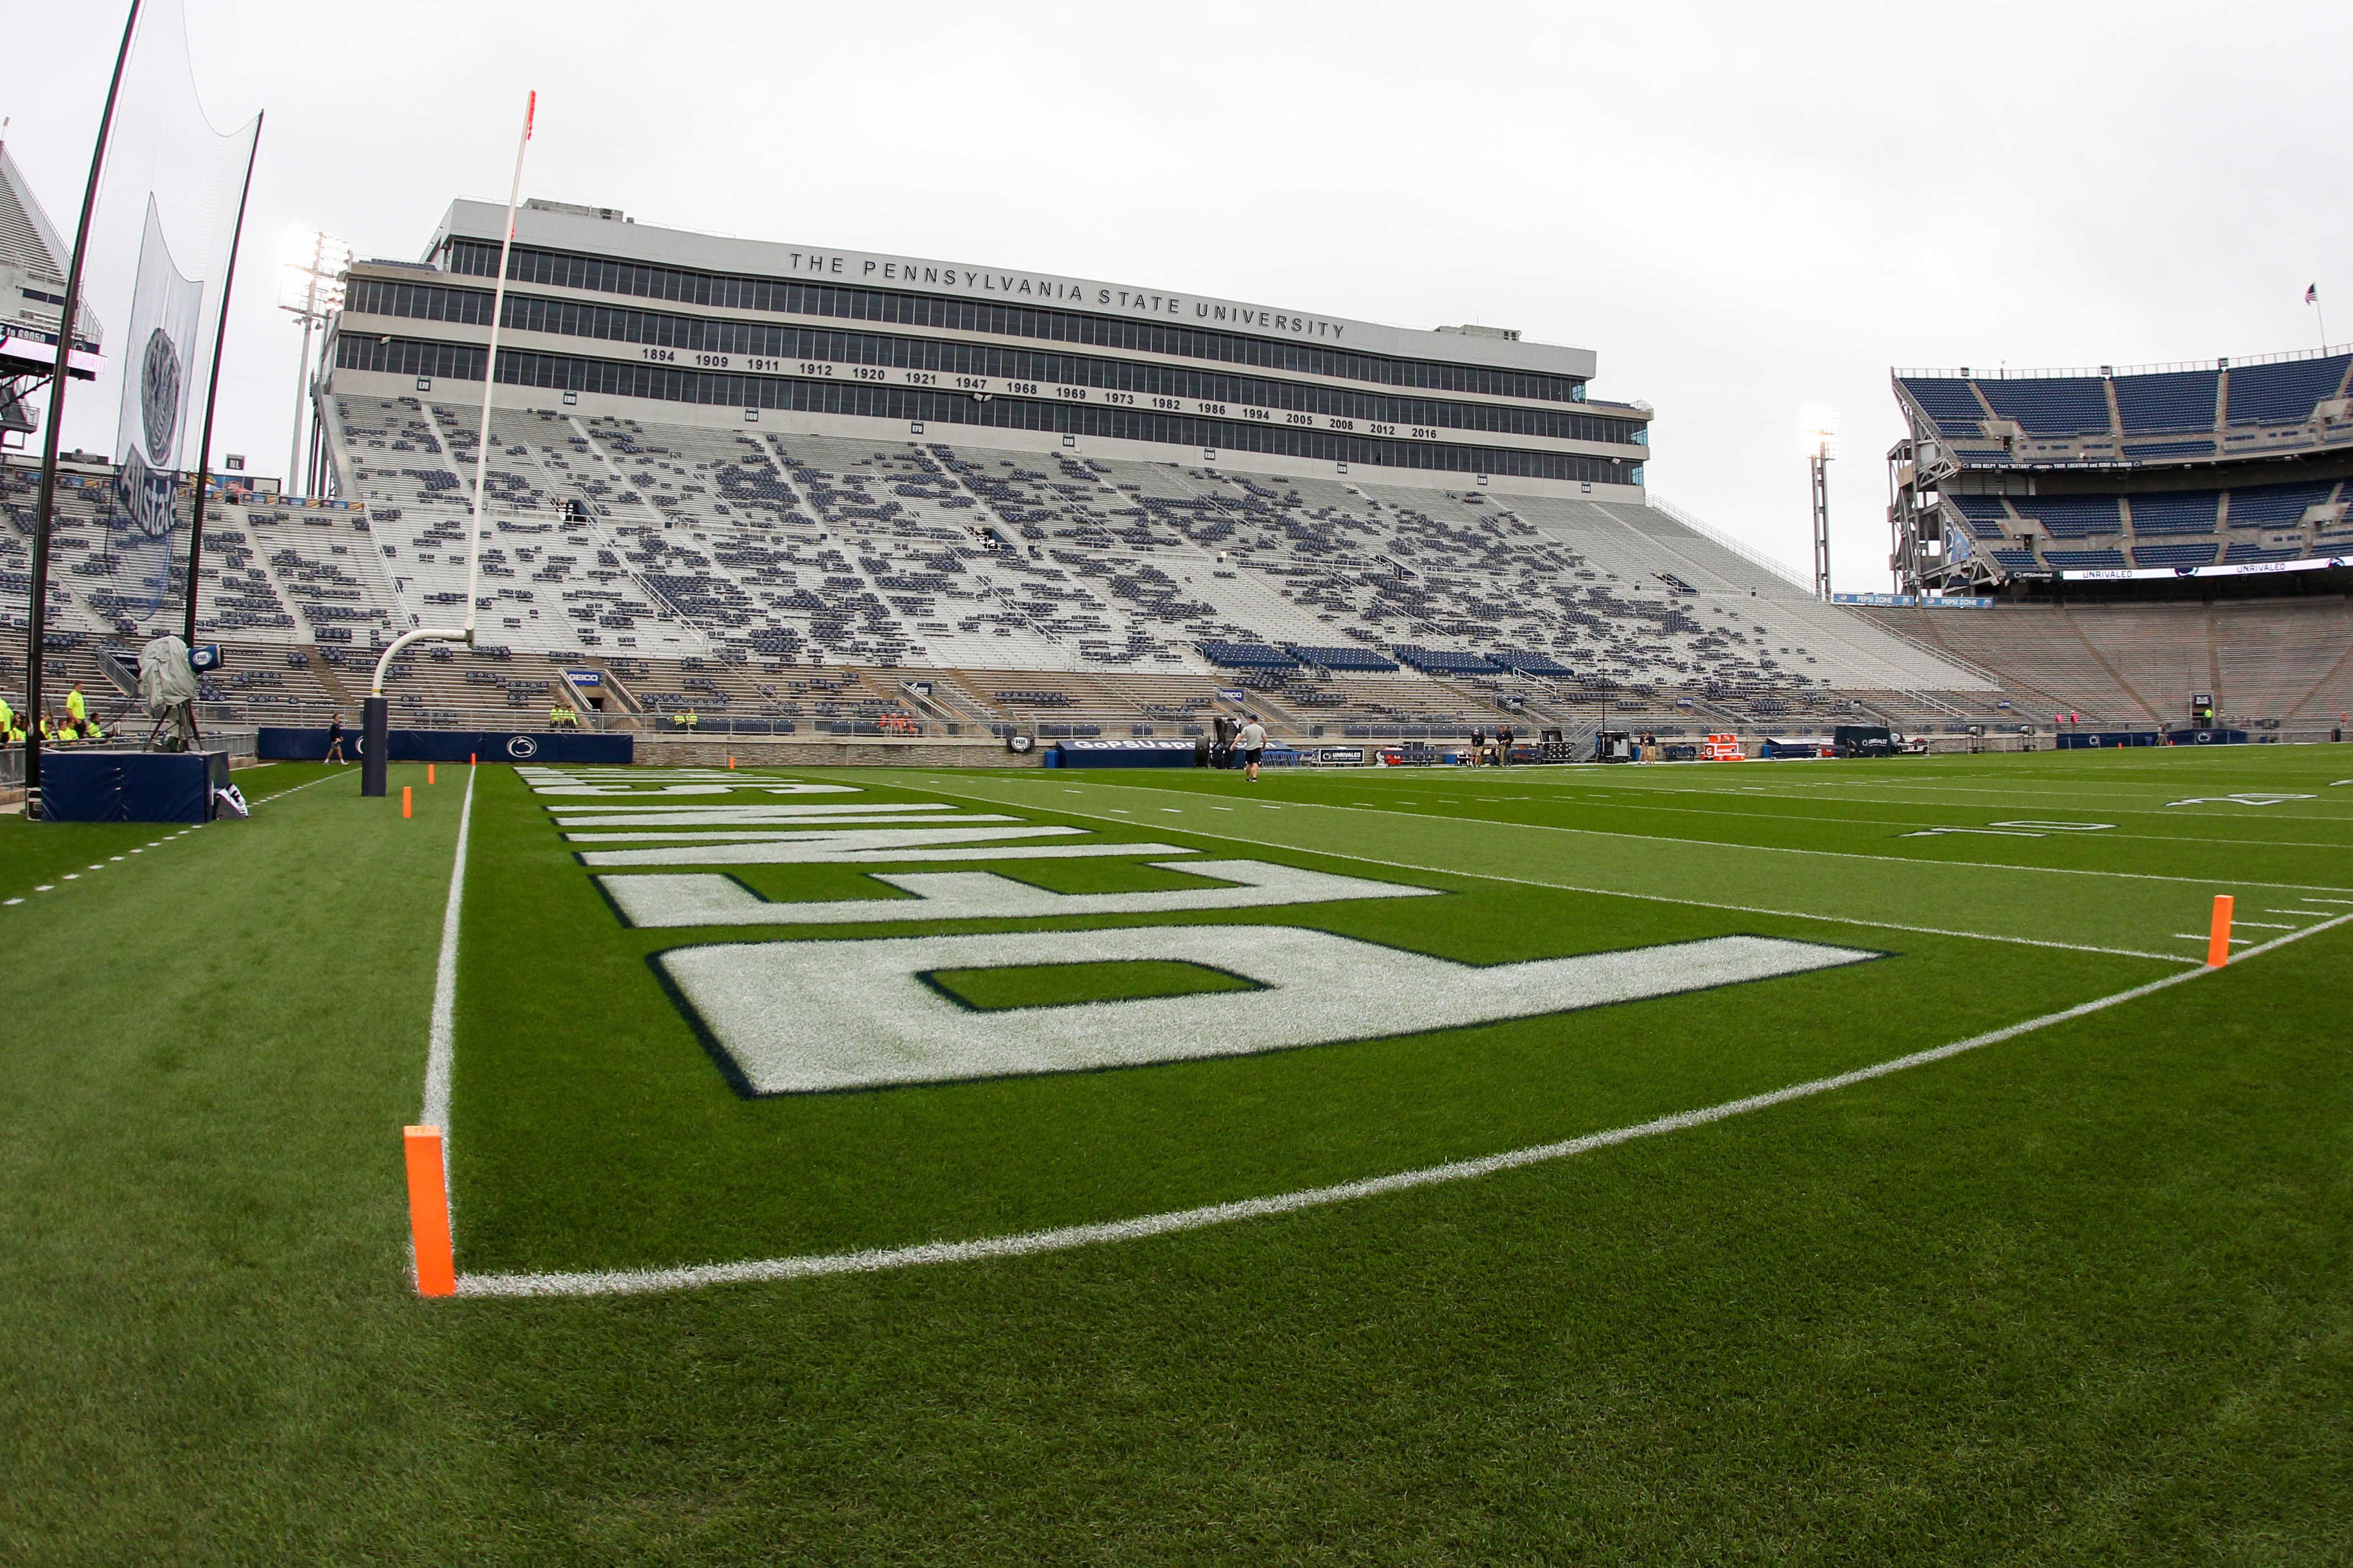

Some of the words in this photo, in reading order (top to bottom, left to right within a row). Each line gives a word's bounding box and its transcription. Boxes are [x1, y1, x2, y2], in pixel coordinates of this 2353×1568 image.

[791, 254, 843, 273] THE
[864, 261, 1083, 300] PENNSYLVANIA
[1099, 289, 1180, 313] STATE
[1197, 303, 1344, 339] UNIVERSITY
[642, 348, 675, 362] 1894
[695, 355, 728, 367] 1909
[747, 359, 778, 371] 1911
[799, 363, 832, 375] 1912
[853, 368, 884, 380] 1920
[906, 372, 936, 384] 1921
[956, 377, 987, 389] 1947
[1007, 382, 1037, 394] 1968
[1056, 387, 1086, 399] 1969
[1105, 392, 1134, 404] 1973
[1152, 397, 1180, 410] 1982
[1198, 402, 1225, 414] 1986
[1243, 408, 1269, 420] 1994
[1286, 413, 1312, 425] 2005
[1330, 419, 1353, 430] 2008
[1370, 424, 1394, 435] 2012
[1412, 428, 1436, 438] 2016
[230, 460, 240, 469] NL
[121, 457, 178, 535] Allstate
[2237, 563, 2285, 573] UNRIVALED
[569, 673, 599, 682] GEICO
